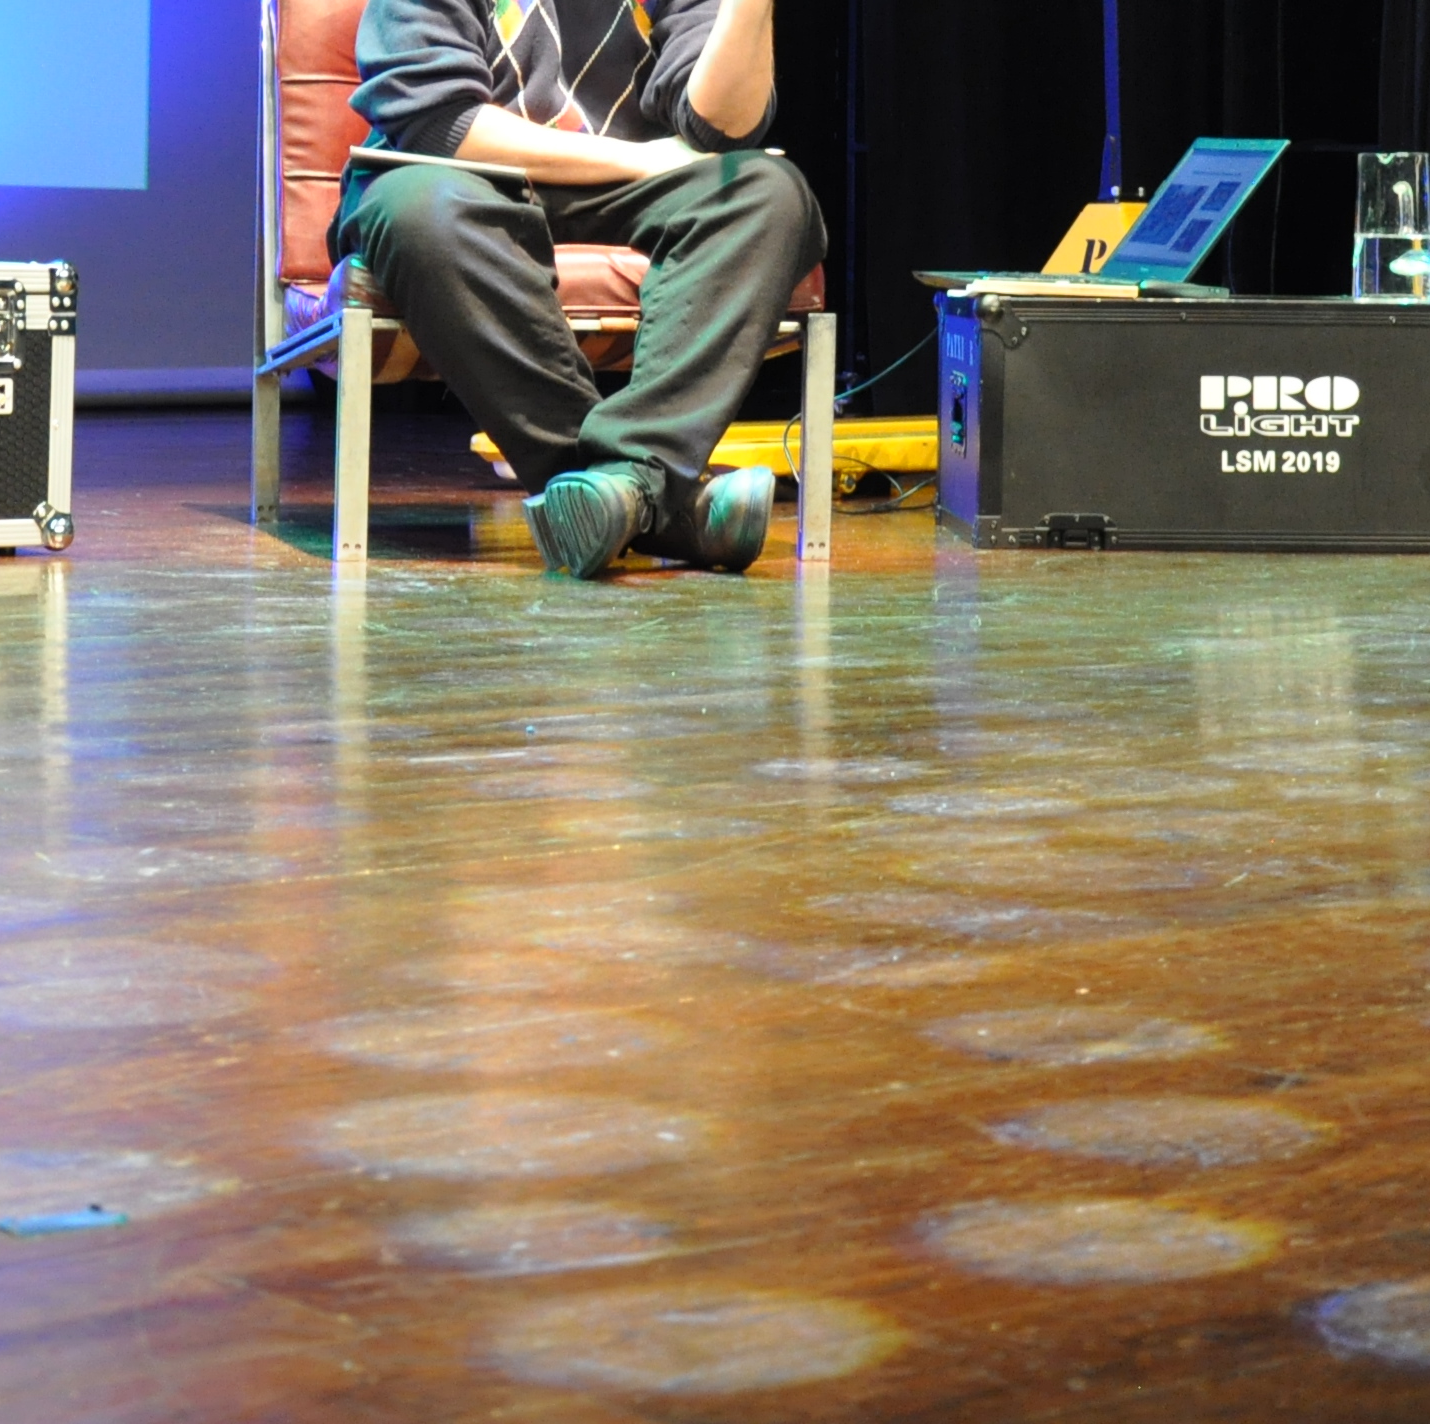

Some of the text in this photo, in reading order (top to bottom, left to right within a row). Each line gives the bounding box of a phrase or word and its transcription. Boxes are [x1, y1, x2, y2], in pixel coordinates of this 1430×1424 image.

[1199, 375, 1361, 411] PRO
[1221, 449, 1341, 473] LSM 2019
